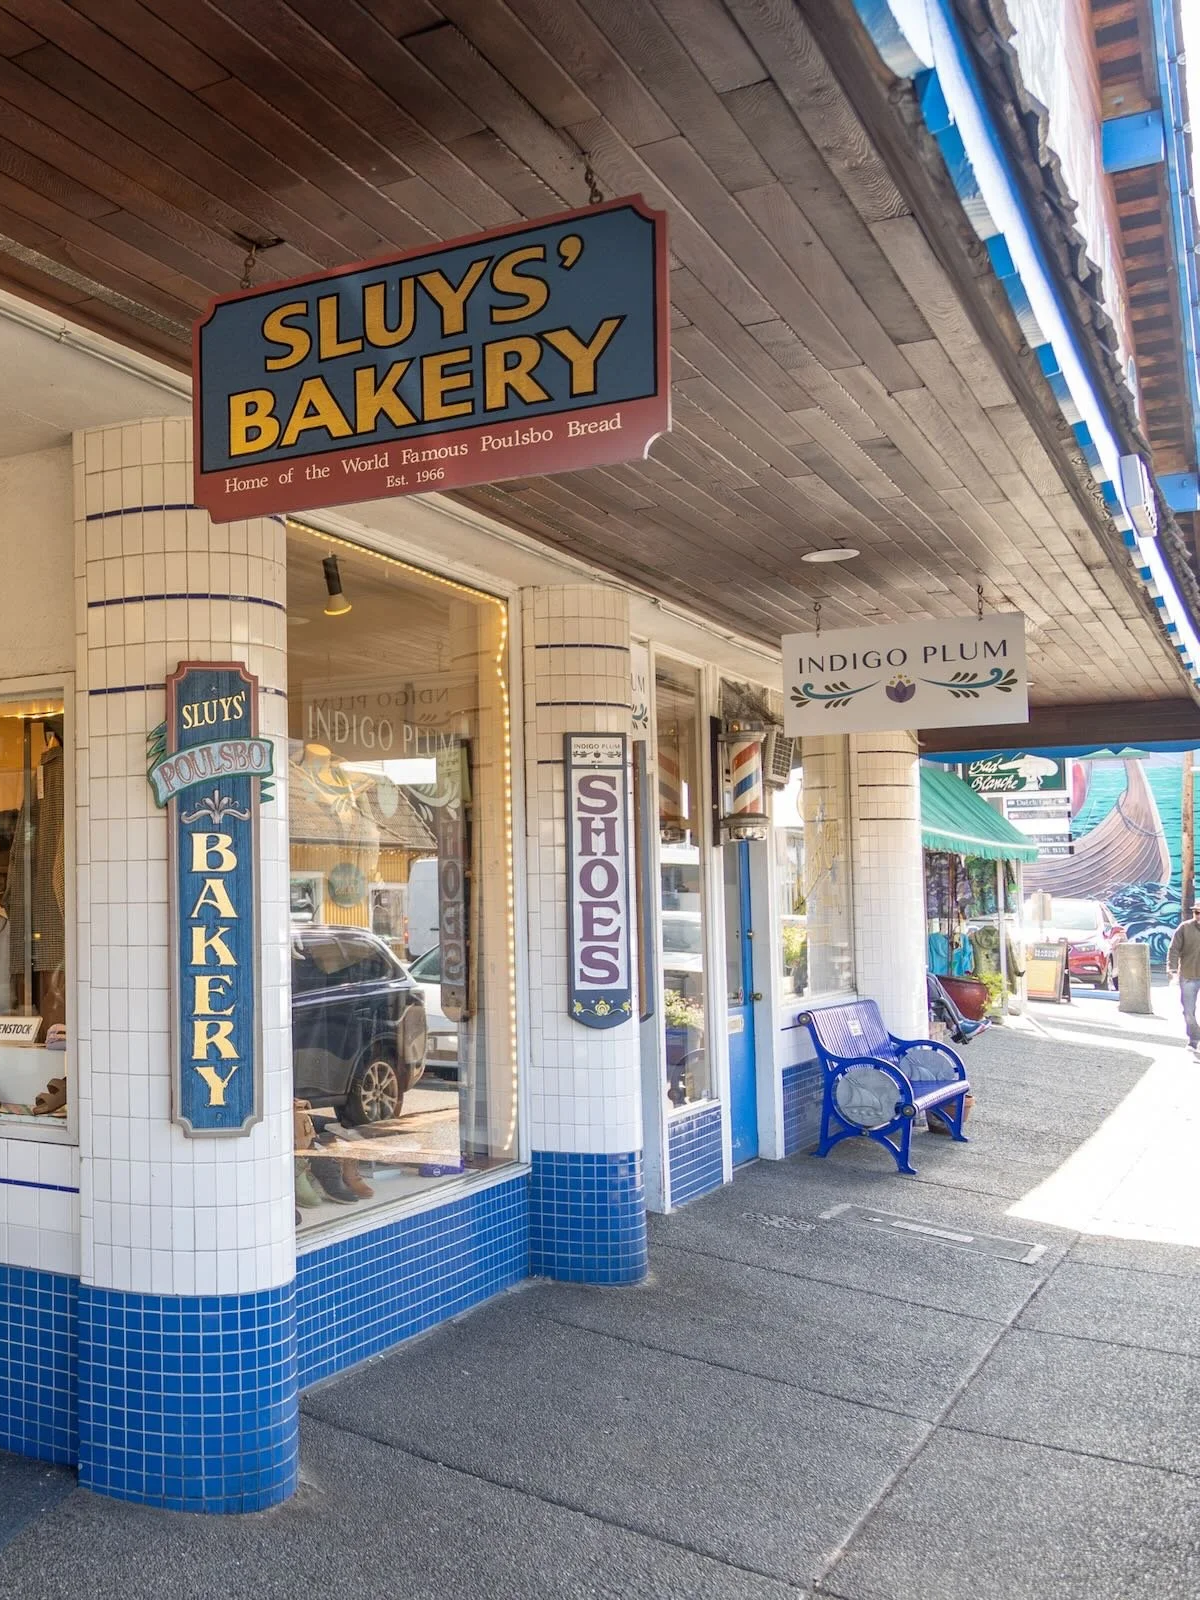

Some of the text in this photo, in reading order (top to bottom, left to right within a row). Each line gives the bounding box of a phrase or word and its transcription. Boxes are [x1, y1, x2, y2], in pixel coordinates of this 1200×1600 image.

[228, 315, 627, 459] BAKERY
[224, 412, 622, 494] Home of the World Famous Poulsbo Bread
[386, 467, 445, 489] Est. 1966
[798, 639, 1008, 675] INDIGO PLUM
[308, 704, 457, 758] INDIGO PLUM
[160, 742, 266, 792] POULSBO
[970, 775, 1019, 792] Blanche
[577, 774, 621, 985] SHOES
[189, 832, 240, 1107] BAKERY
